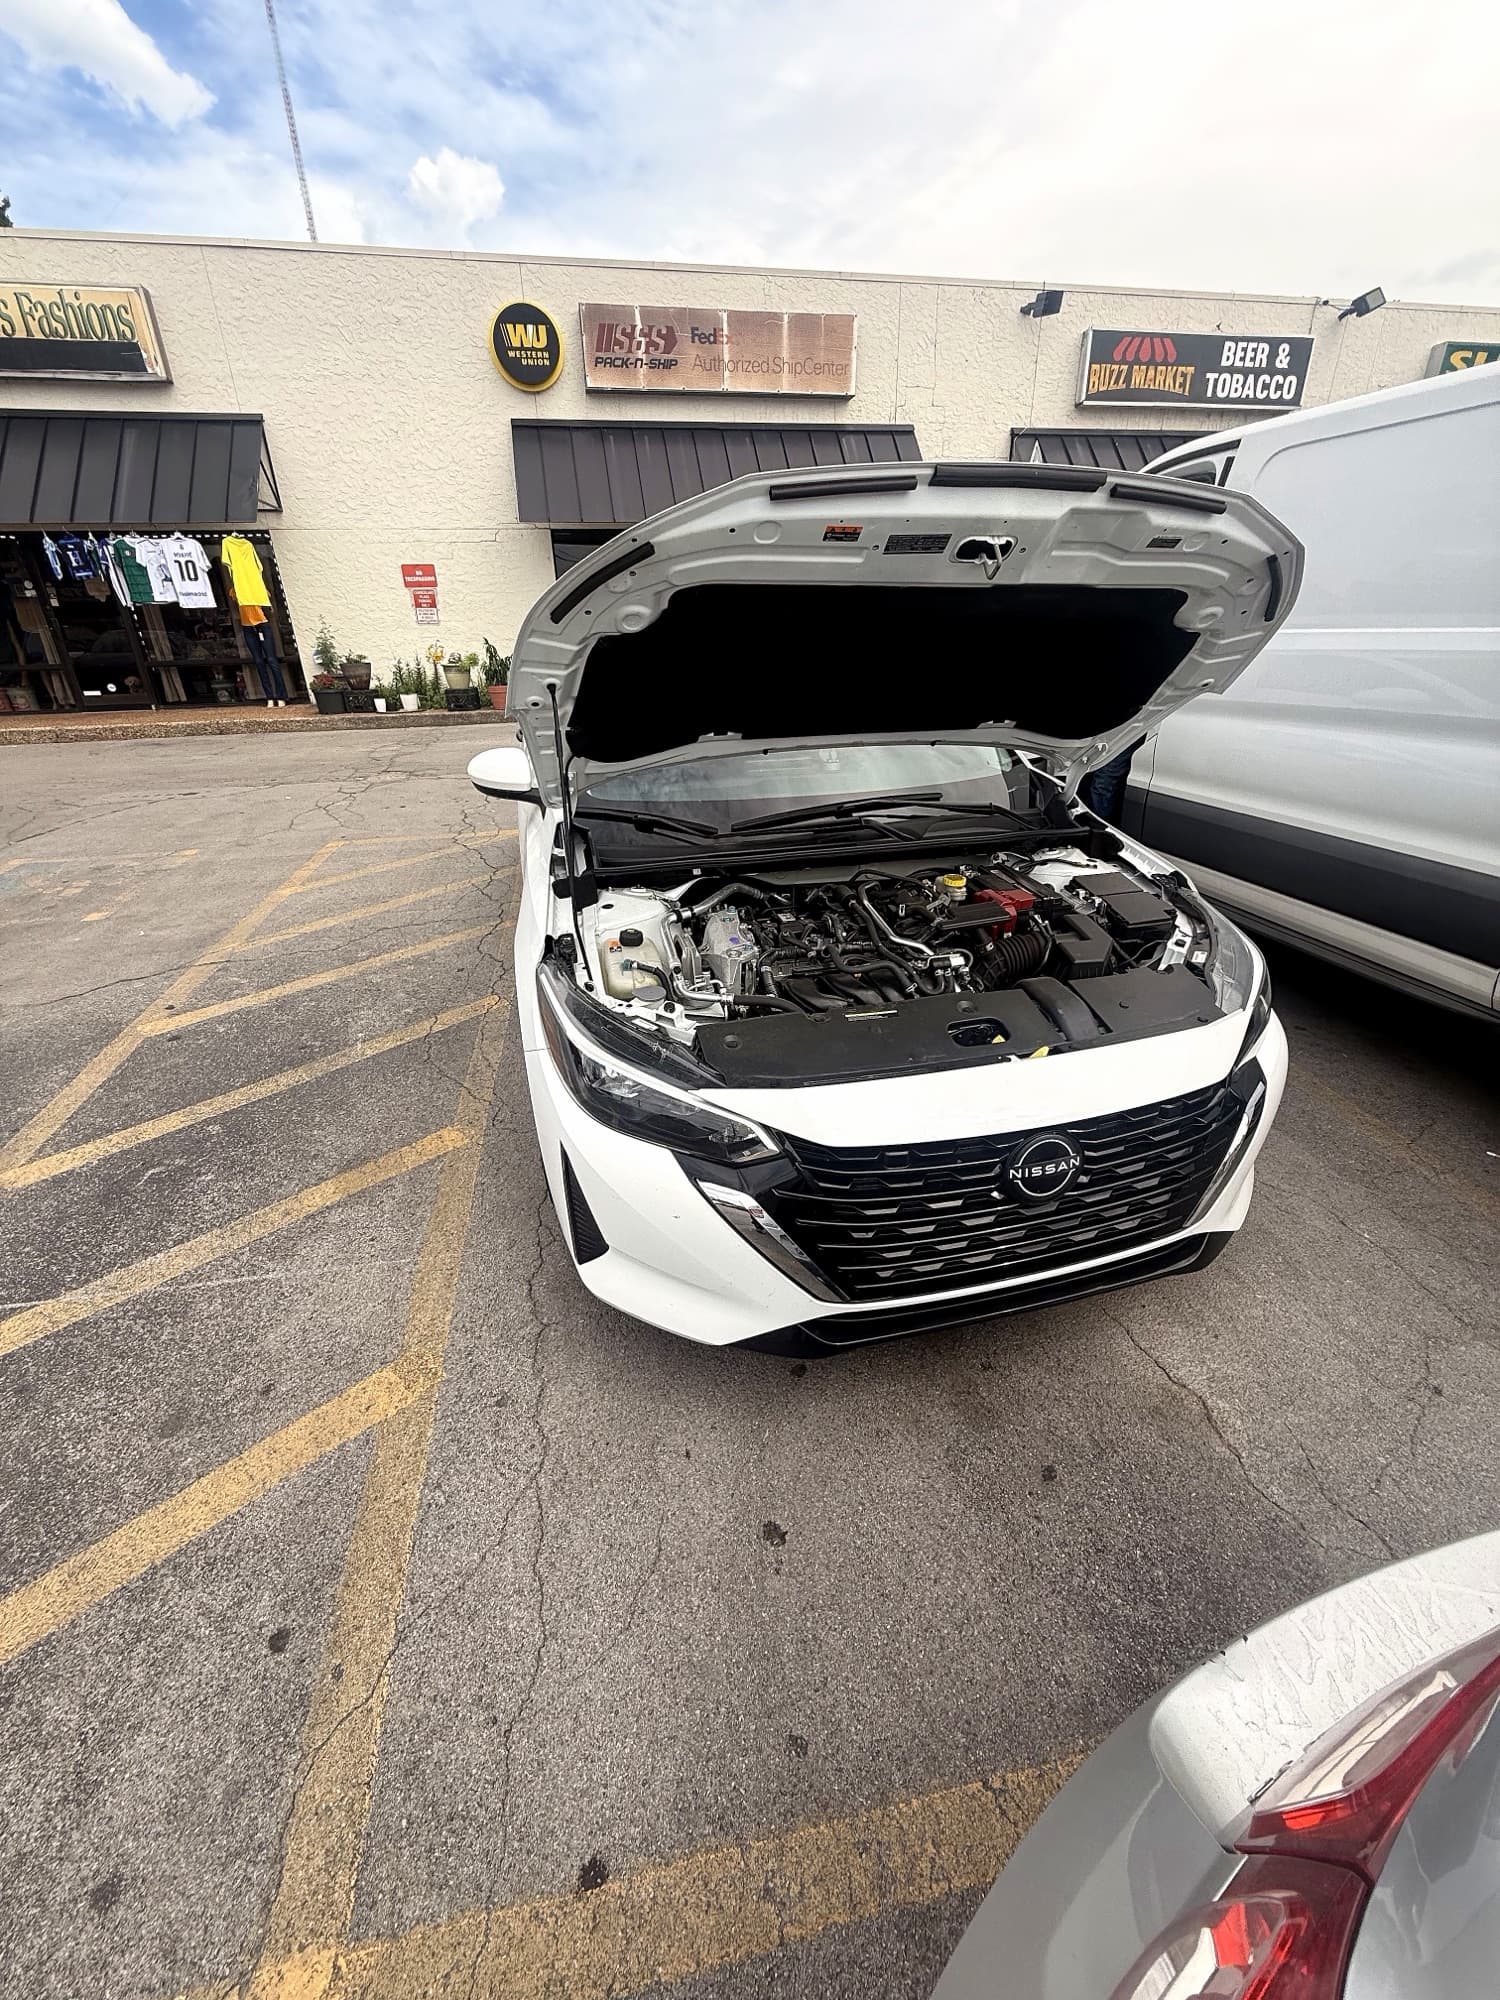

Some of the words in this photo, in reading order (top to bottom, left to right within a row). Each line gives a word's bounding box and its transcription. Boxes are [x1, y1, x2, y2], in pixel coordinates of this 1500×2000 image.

[14, 289, 136, 341] Fashions
[506, 323, 548, 349] WU
[507, 350, 550, 359] WESTERN
[521, 358, 551, 367] UNION
[692, 354, 770, 374] Authorized
[1220, 341, 1270, 368] BEER
[1275, 343, 1291, 369] &
[1088, 363, 1129, 395] BUZZ
[1130, 365, 1196, 396] MARKET
[1206, 372, 1299, 400] TOBACCO
[173, 559, 199, 582] 10
[1009, 1156, 1080, 1179] NISSAN
